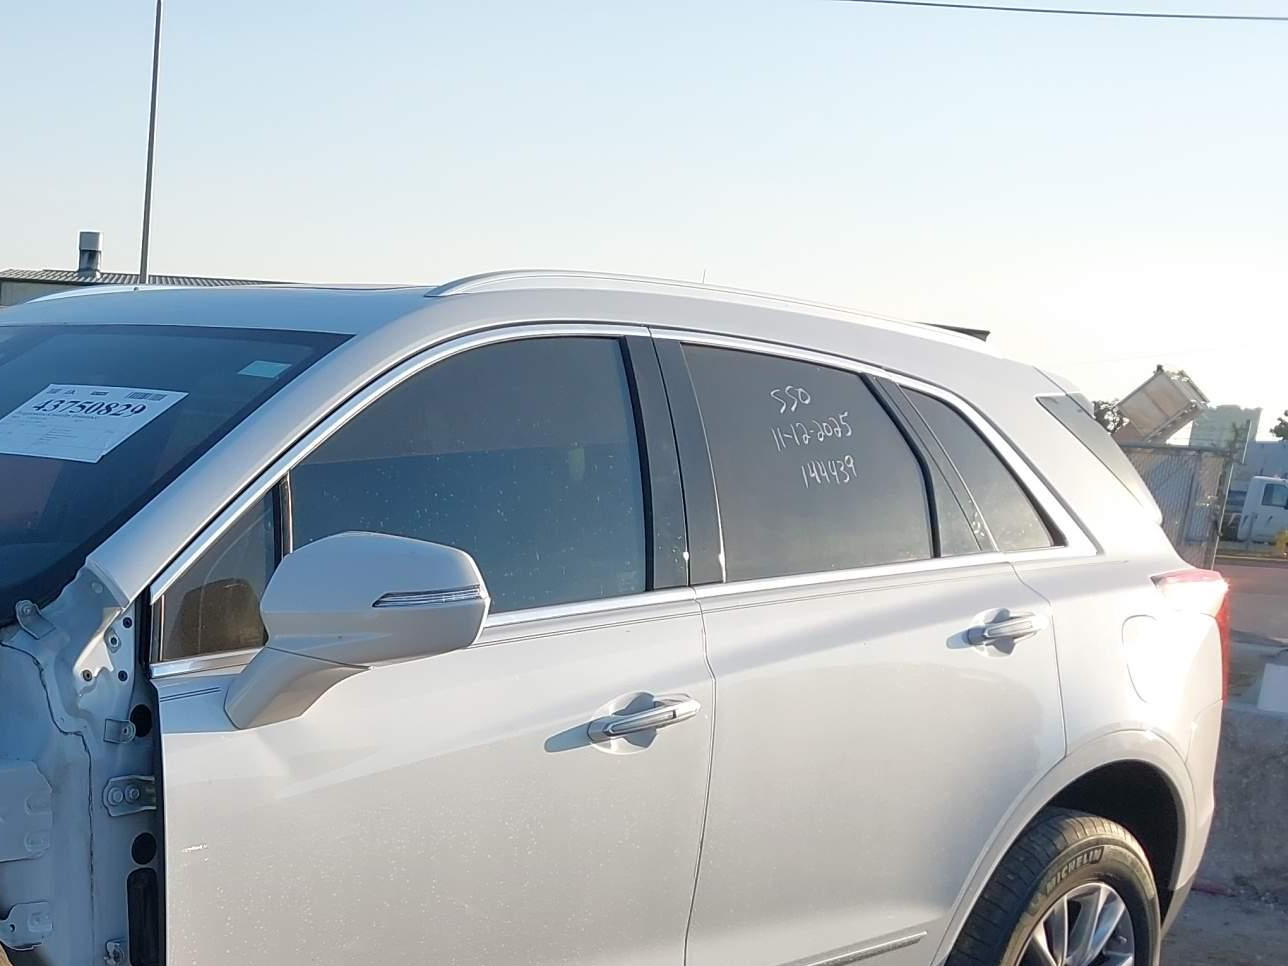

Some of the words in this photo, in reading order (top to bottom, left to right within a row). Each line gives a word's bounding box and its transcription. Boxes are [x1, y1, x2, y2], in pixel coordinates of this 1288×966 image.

[31, 399, 147, 418] 43750829
[771, 411, 852, 452] 11-12-2025
[800, 454, 858, 489] 144439
[1045, 847, 1104, 896] MICHELIN
